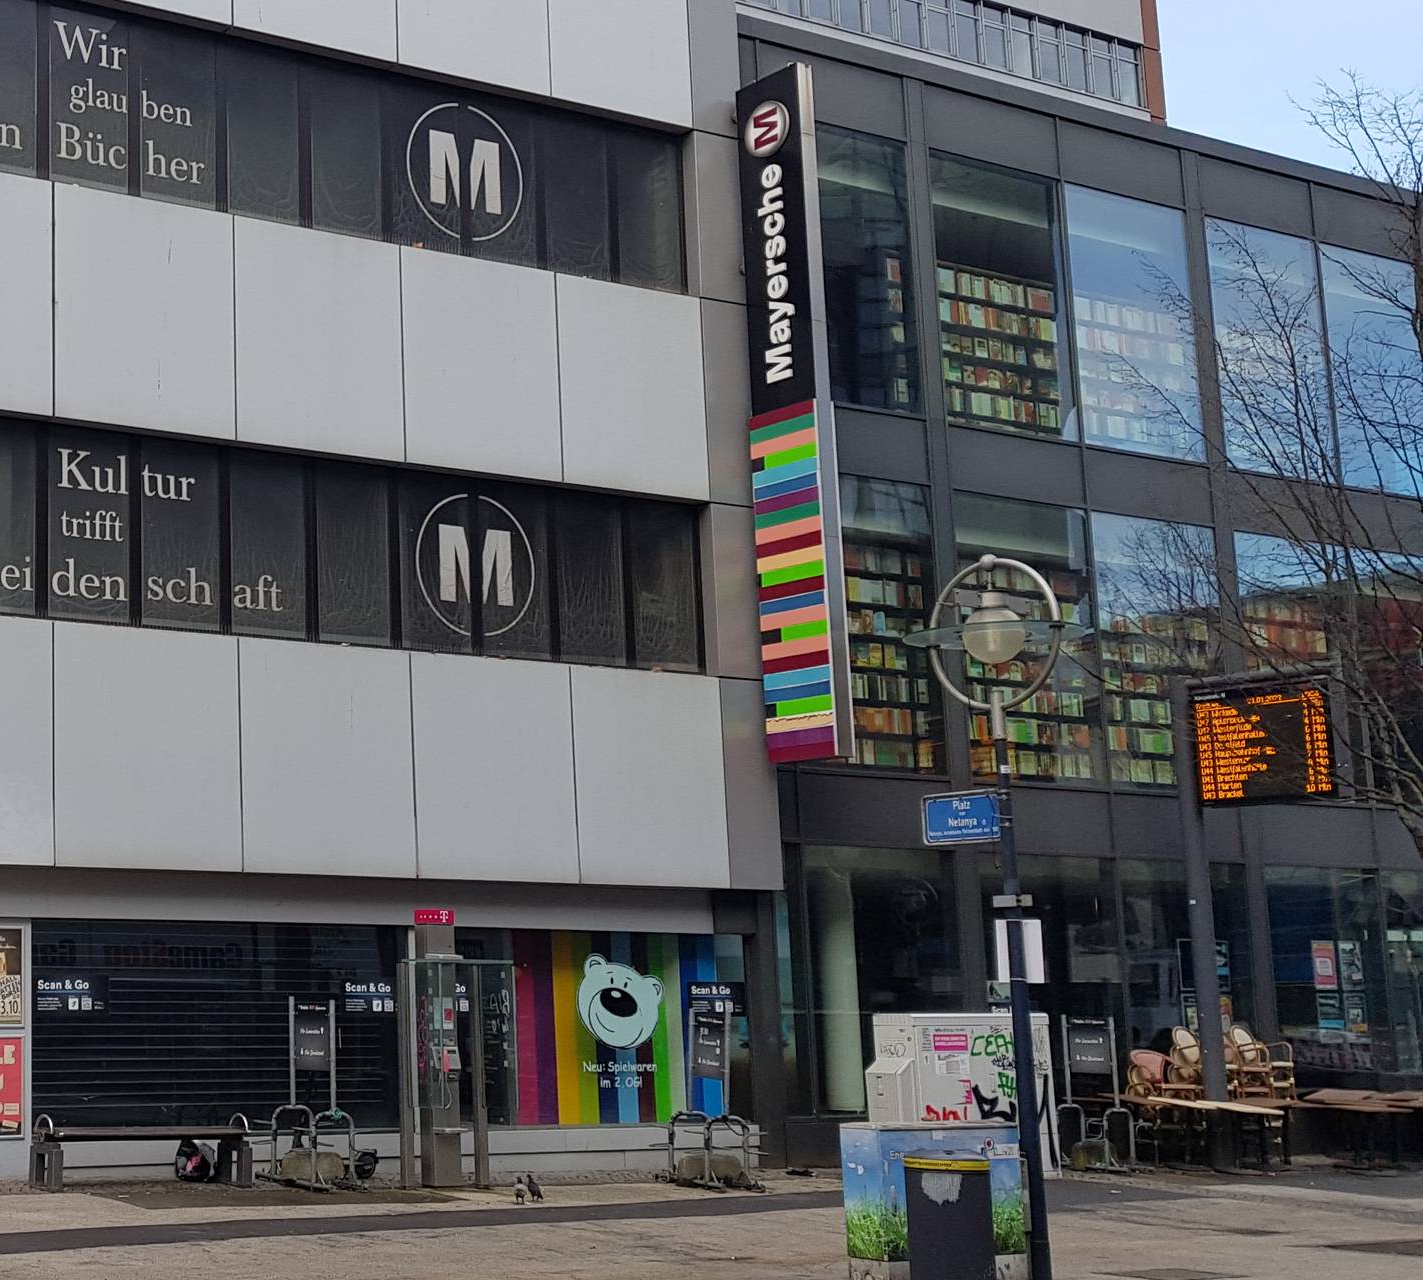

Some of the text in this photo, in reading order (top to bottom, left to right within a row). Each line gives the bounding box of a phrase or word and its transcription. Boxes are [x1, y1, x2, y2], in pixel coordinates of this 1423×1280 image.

[53, 20, 127, 71] Wir
[758, 162, 796, 385] Mayersche
[60, 510, 124, 542] trifft
[952, 800, 971, 810] Platz
[947, 817, 978, 828] Netanya
[37, 979, 90, 990] Scan & Go
[345, 982, 391, 993] Scan & Go
[690, 985, 731, 995] Scan & Go
[582, 1060, 658, 1075] Neu: Spielwaren
[599, 1077, 611, 1088] im
